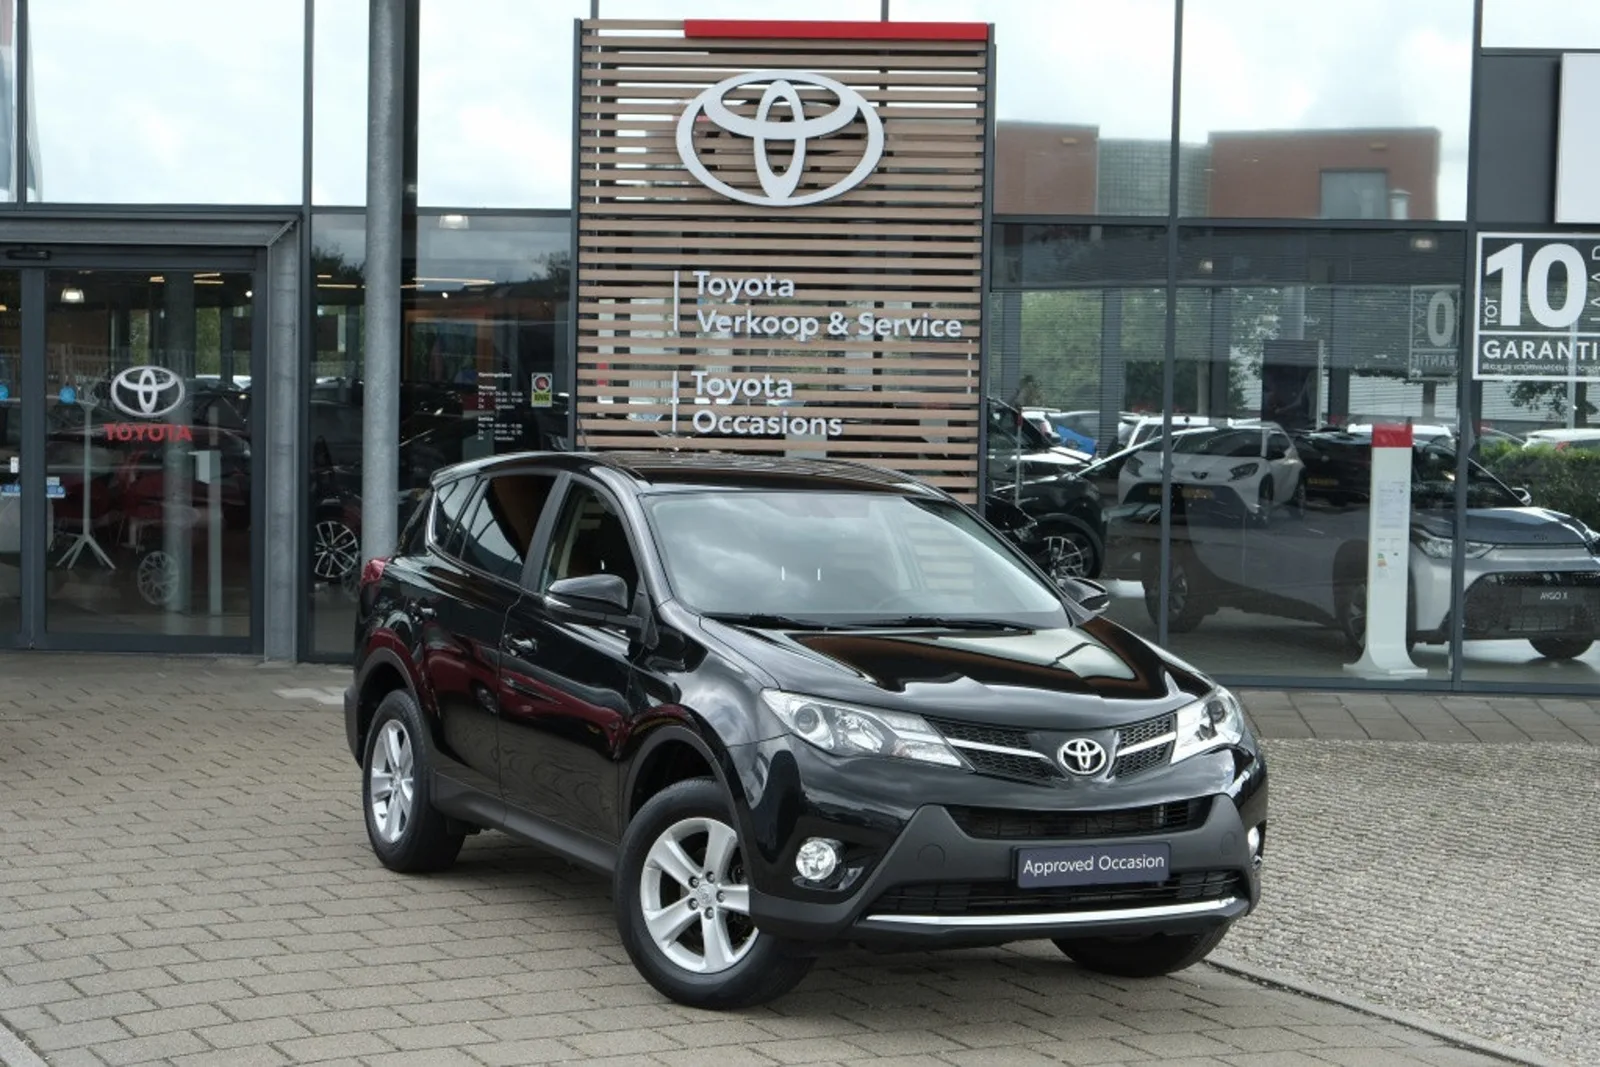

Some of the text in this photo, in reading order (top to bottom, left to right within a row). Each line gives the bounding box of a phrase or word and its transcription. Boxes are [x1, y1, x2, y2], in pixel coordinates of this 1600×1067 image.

[693, 271, 795, 303] Toyota
[1486, 243, 1588, 328] 10
[697, 309, 963, 342] Verkoop & Service
[1484, 297, 1498, 325] TOT
[691, 371, 793, 404] Toyota
[103, 423, 193, 442] TOYOTA
[693, 410, 843, 436] Occasions
[1023, 854, 1165, 877] Approved Occasion
